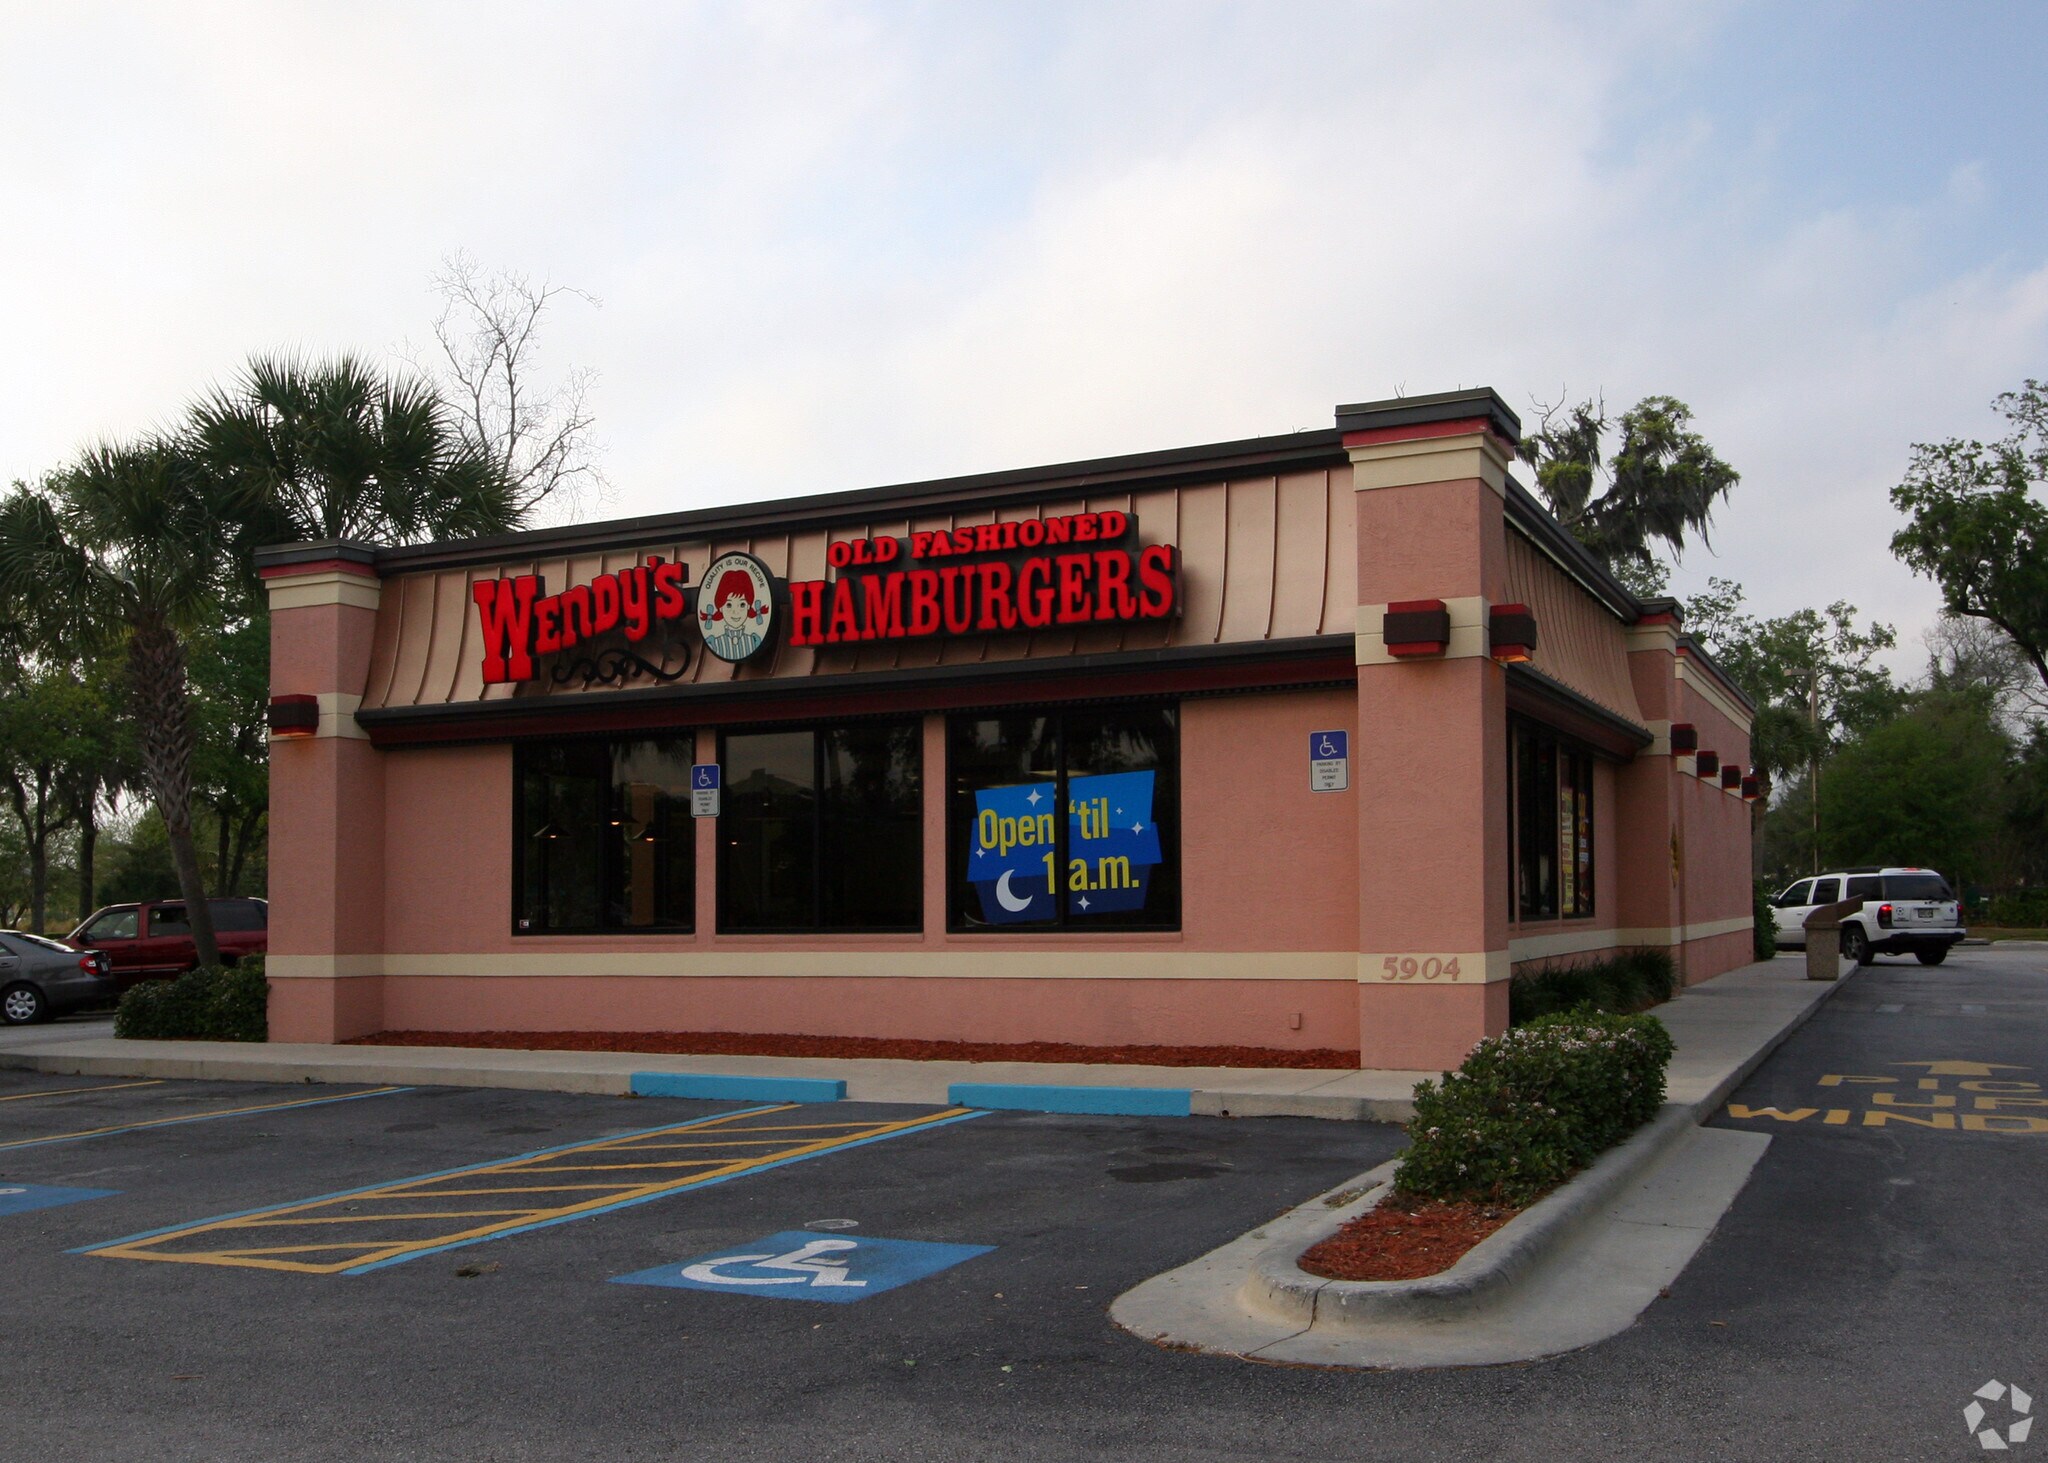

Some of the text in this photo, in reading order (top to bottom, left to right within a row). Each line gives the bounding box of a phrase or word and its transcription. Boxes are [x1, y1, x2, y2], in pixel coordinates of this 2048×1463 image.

[828, 511, 1127, 568] OLD FASHIONED
[705, 563, 724, 590] QUALITY
[734, 558, 749, 567] OUR
[749, 564, 765, 589] RECIPE
[473, 544, 1174, 684] Wendy's HAMBURGERS
[978, 808, 1056, 857] Open
[1042, 851, 1140, 895] 1 a.m.
[1380, 956, 1461, 982] 5904
[1727, 1104, 2048, 1133] WIND
[1872, 1092, 2048, 1110] UP
